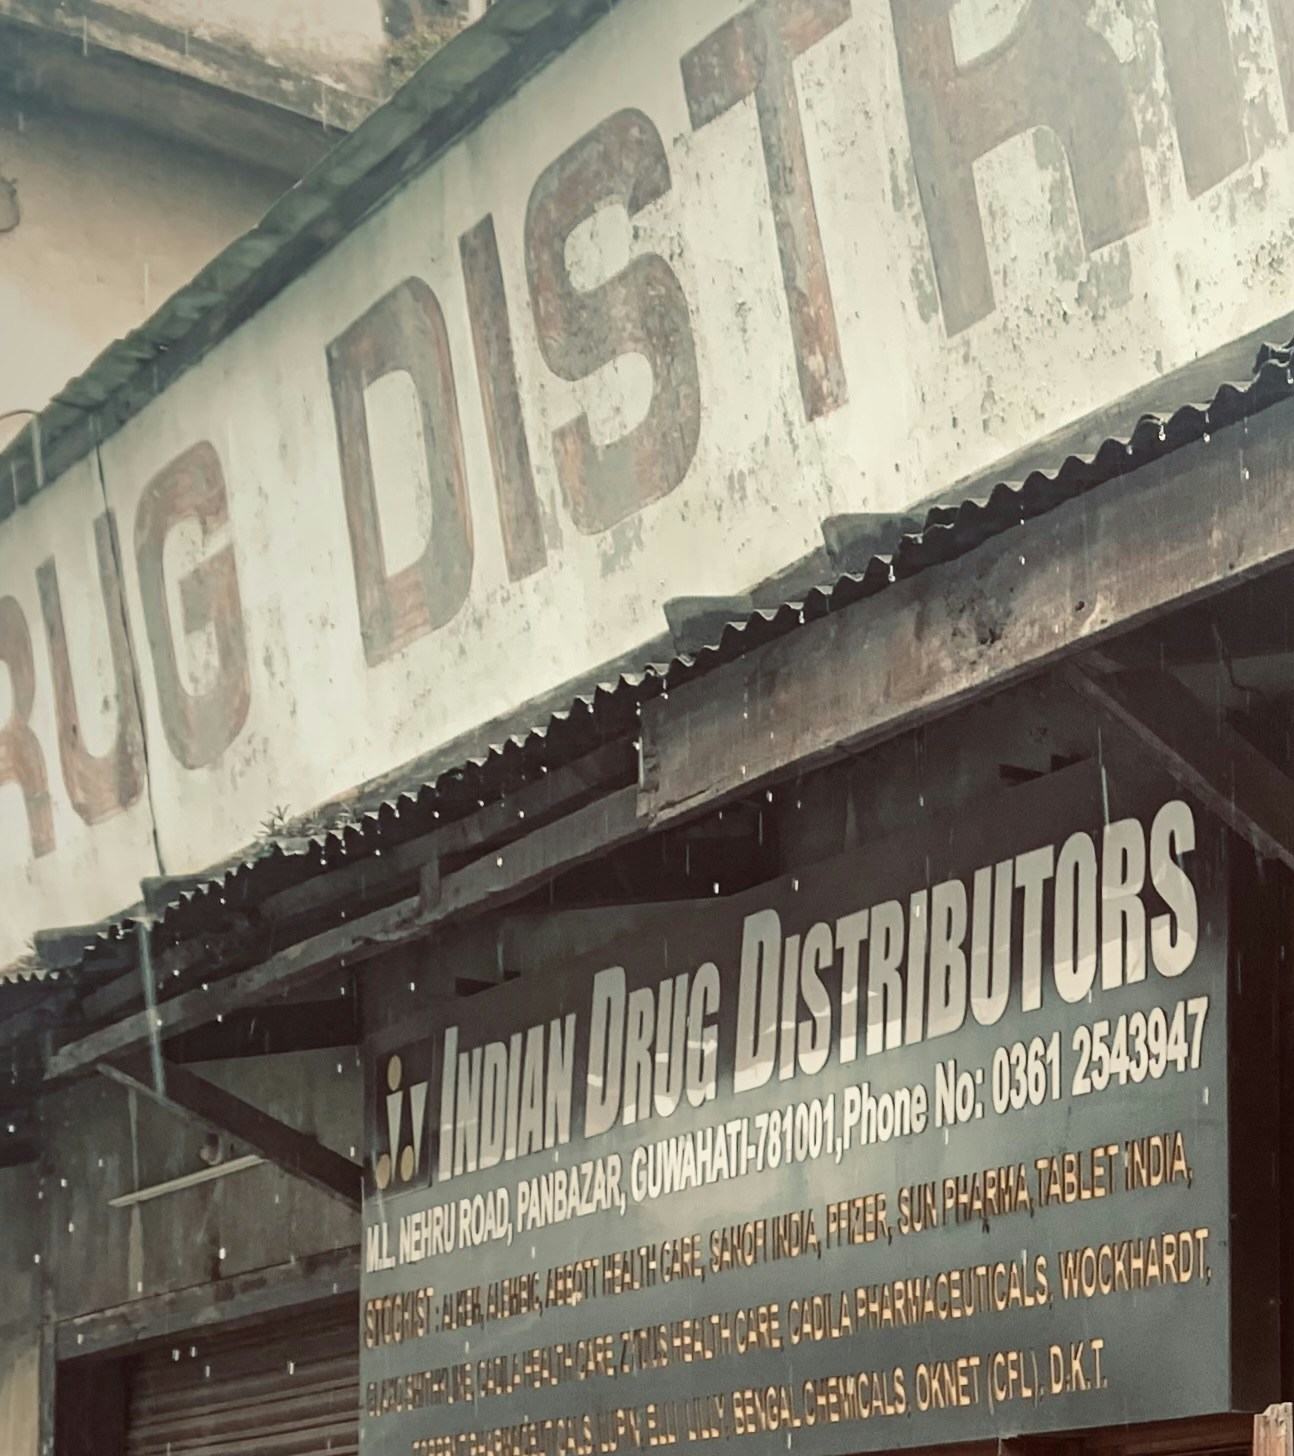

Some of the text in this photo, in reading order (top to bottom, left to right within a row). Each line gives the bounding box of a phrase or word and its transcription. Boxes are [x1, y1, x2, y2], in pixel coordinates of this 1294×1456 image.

[438, 800, 1198, 1181] INDIAN DRUG DISTRIBUTORS
[399, 1198, 456, 1263] NEHRU
[459, 1187, 514, 1249] ROAD,
[517, 1153, 627, 1234] PANBAZAR,
[935, 1059, 984, 1128] No:
[992, 1032, 1061, 1114] 0361
[1072, 996, 1209, 1097] 2543947
[602, 1244, 657, 1294] HEALTH
[660, 1235, 706, 1283] CARE,
[709, 1218, 767, 1273] SANOFI
[771, 1209, 821, 1258] INDIA,
[825, 1193, 893, 1248] PFIZER,
[898, 1182, 937, 1235] SUN
[942, 1164, 1034, 1224] PHARMA,
[1035, 1144, 1119, 1206] TABLET
[1124, 1131, 1193, 1190] INDIA,
[670, 1312, 731, 1363] HEALTH
[788, 1290, 852, 1344] CADILA
[1058, 1227, 1212, 1300] WOCKHARDT,
[732, 1386, 801, 1435] BENGAL
[915, 1357, 981, 1411] OKNET
